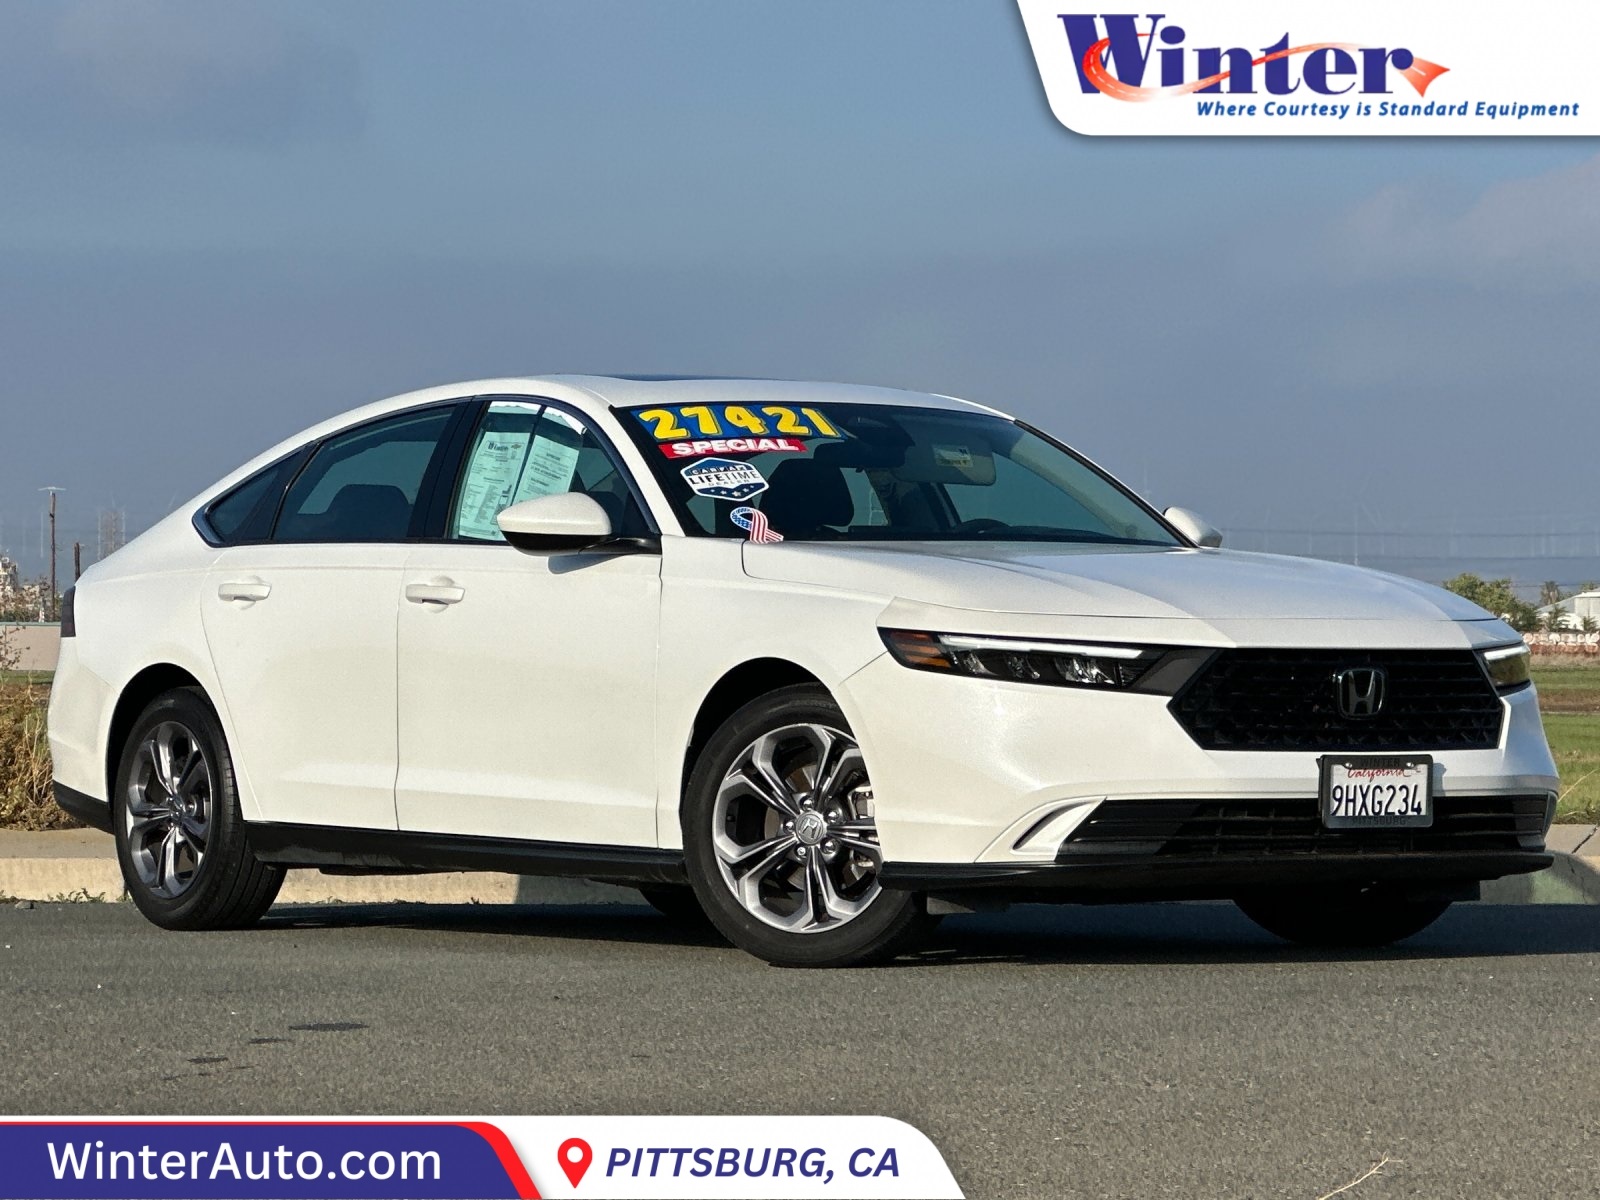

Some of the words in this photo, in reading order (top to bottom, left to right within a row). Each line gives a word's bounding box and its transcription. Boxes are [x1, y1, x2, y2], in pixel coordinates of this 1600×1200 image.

[638, 405, 842, 439] 27421
[671, 437, 800, 456] SPECIAL
[689, 471, 760, 485] LIFETIME
[691, 465, 747, 475] CARFAX
[1359, 757, 1401, 768] WINTER
[1330, 784, 1422, 816] 9HXG234
